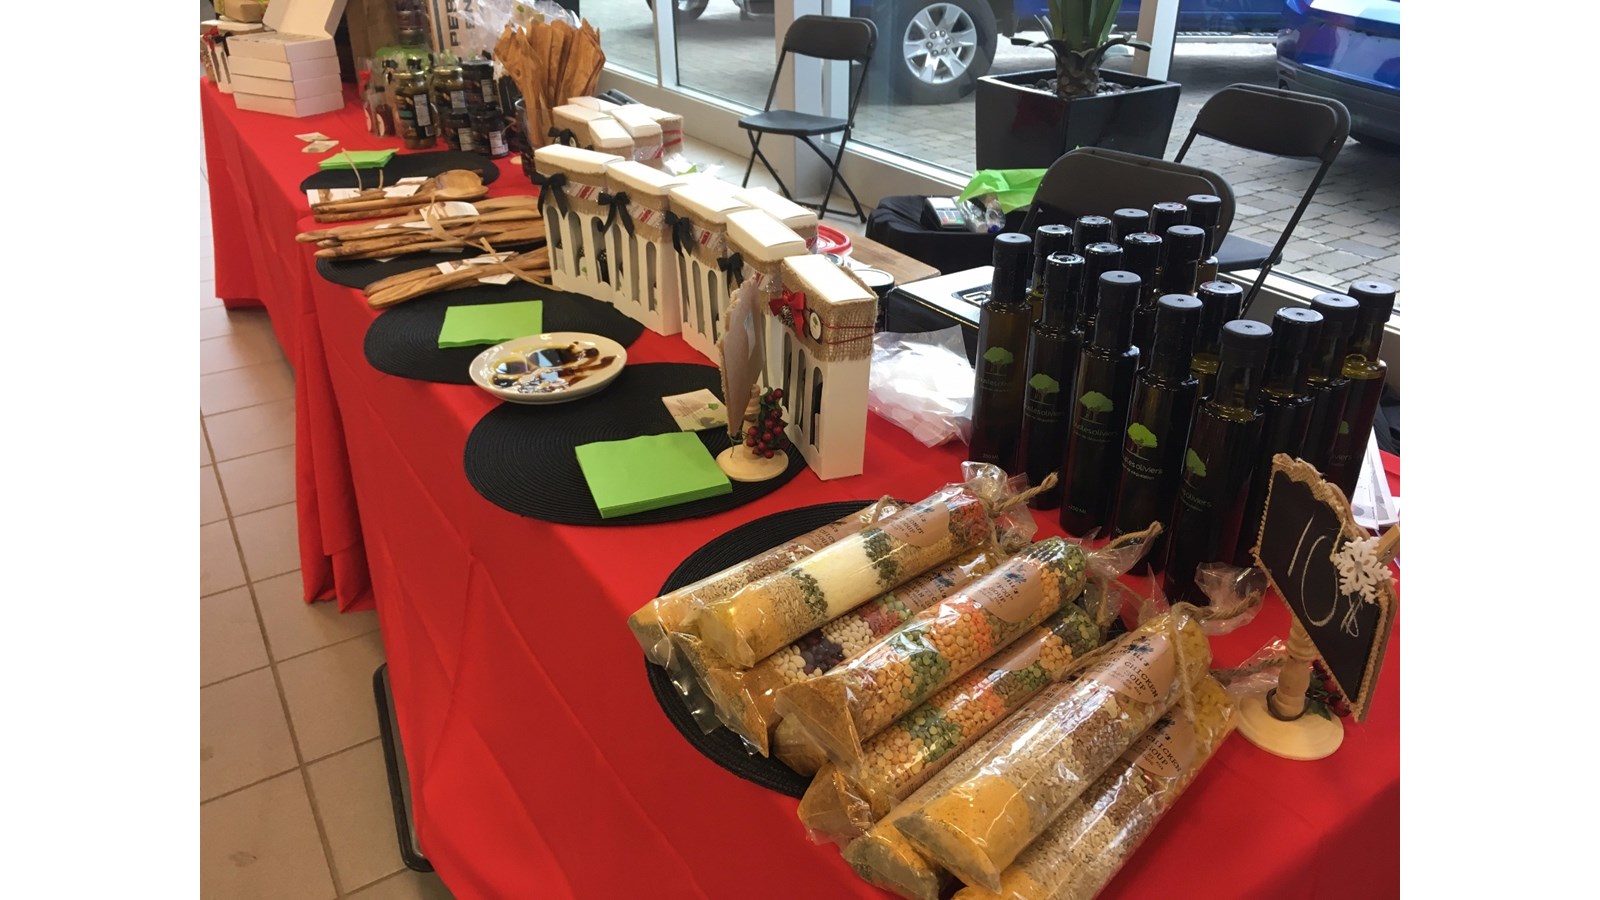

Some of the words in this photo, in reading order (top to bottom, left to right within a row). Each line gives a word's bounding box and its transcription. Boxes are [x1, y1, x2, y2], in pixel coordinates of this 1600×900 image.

[1124, 661, 1159, 698] CHICKEN
[1124, 670, 1146, 691] SOUP
[1146, 734, 1182, 772] CHICKEN
